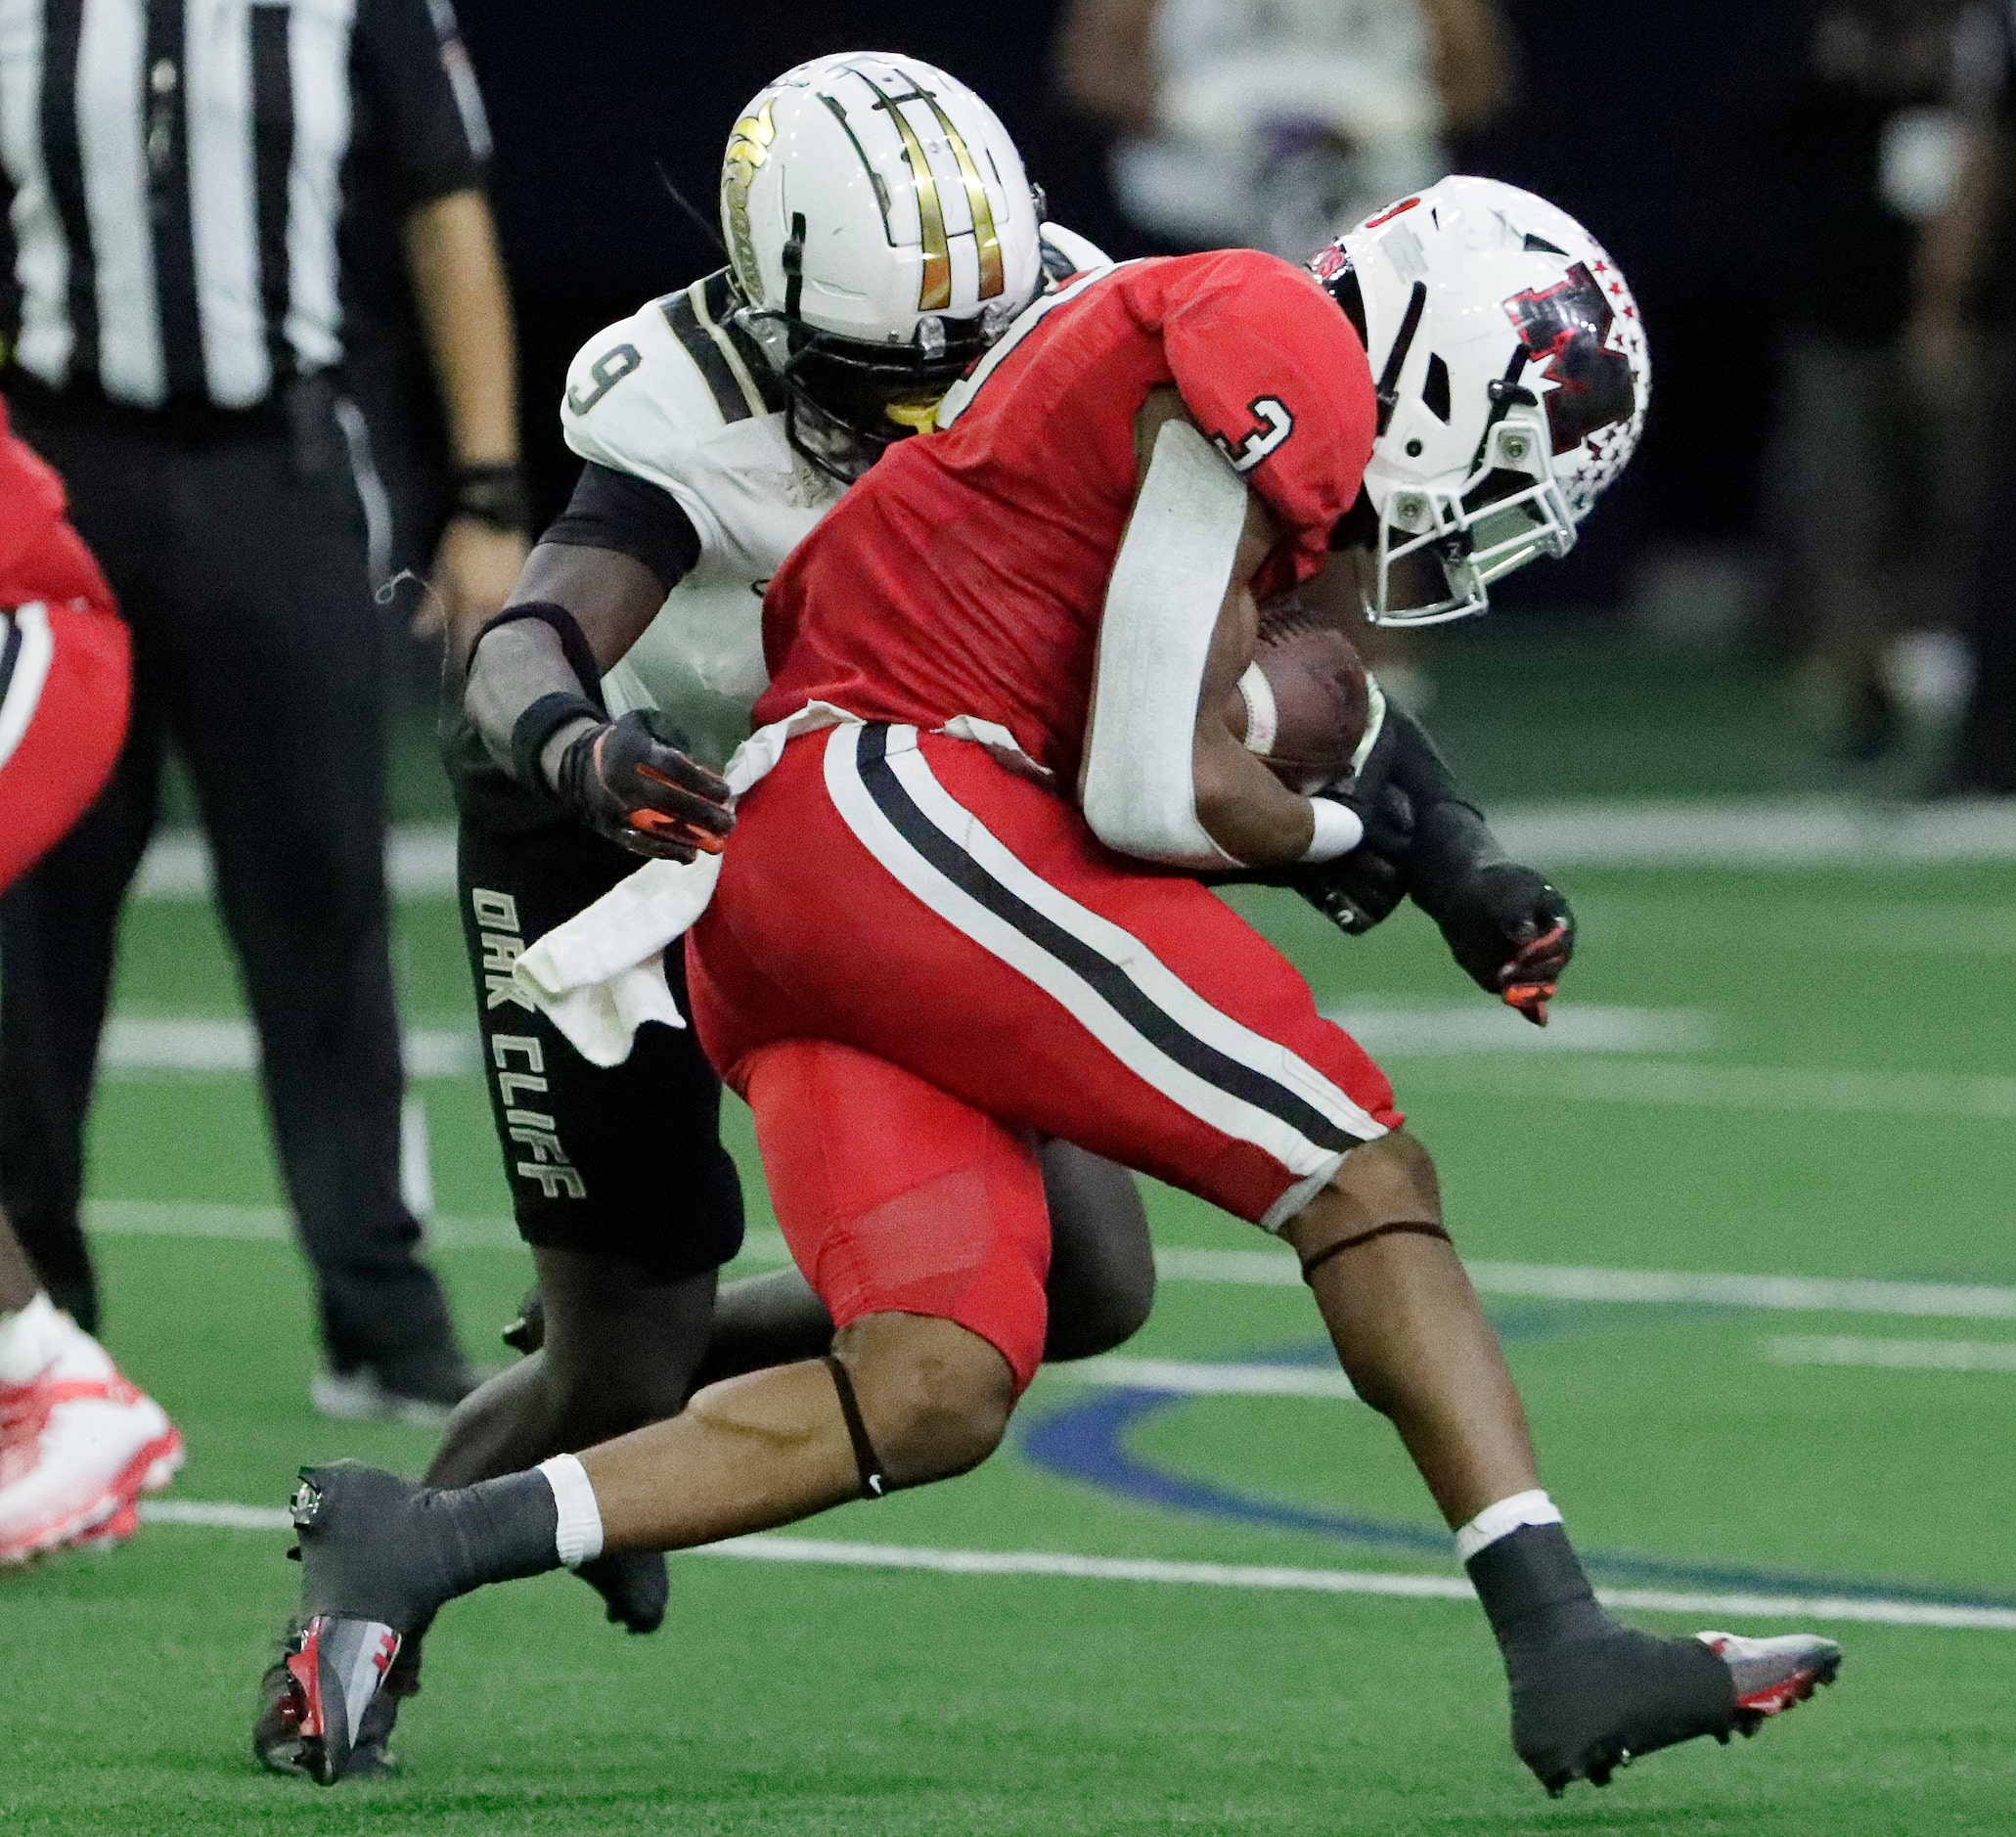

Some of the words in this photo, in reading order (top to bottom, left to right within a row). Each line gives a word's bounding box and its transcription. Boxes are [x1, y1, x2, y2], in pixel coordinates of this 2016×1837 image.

[566, 342, 643, 418] 9
[1503, 260, 1635, 456] M
[1211, 395, 1294, 473] 3
[471, 887, 537, 1014] OAK
[491, 1033, 588, 1199] CLIFF
